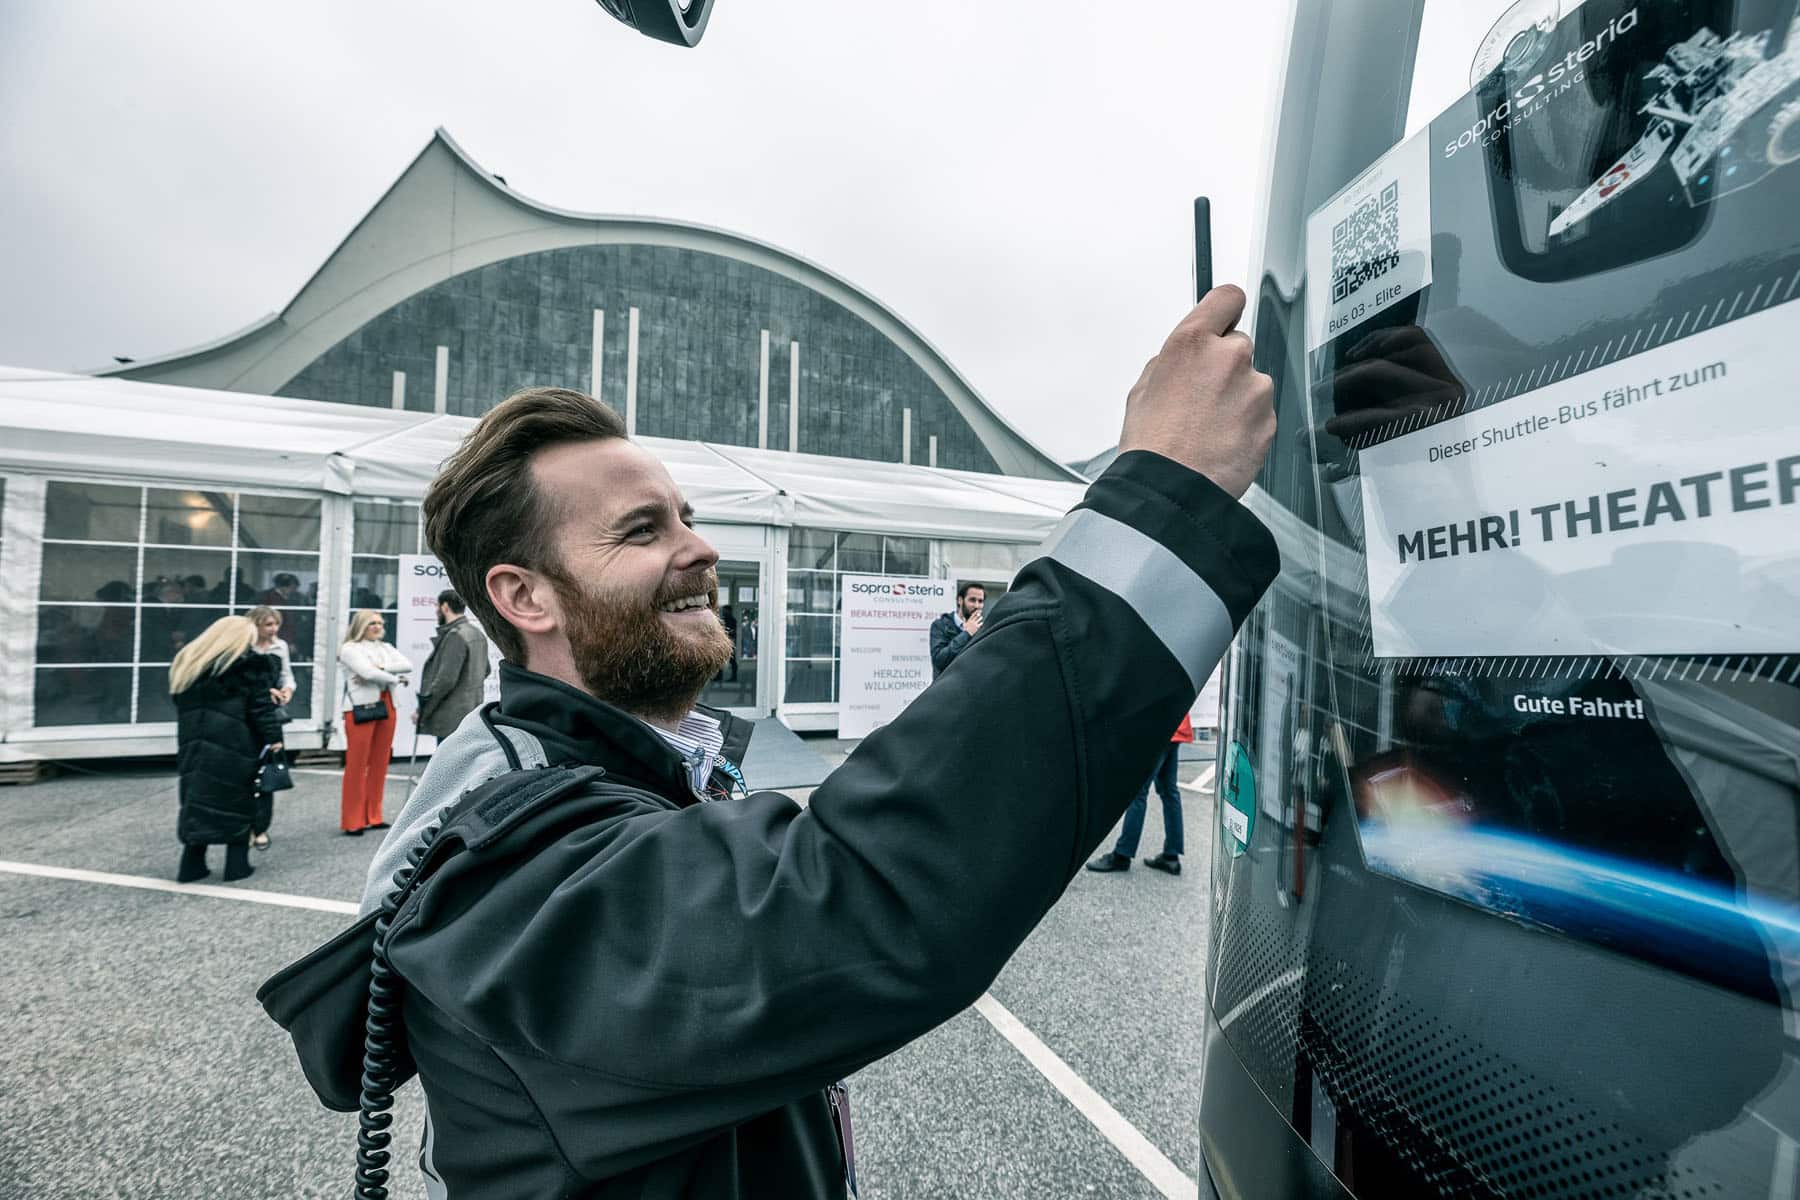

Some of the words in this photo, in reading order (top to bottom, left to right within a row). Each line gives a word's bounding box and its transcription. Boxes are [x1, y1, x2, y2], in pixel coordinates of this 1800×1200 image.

[1444, 99, 1511, 159] sopra
[1547, 7, 1638, 84] steria
[1481, 71, 1585, 148] CONSULTING
[1329, 314, 1349, 333] Bus
[1351, 303, 1365, 320] 03
[1376, 284, 1402, 306] Elite
[1428, 436, 1478, 463] Dieser
[1481, 399, 1598, 448] Shuttle-Bus
[1602, 377, 1662, 411] fährt
[1668, 361, 1727, 392] zum
[1398, 509, 1521, 564] MEHR!
[851, 583, 890, 596] sopra
[908, 584, 944, 597] steria
[850, 609, 922, 619] BERATERTREFFEN
[864, 681, 930, 691] WILLKOMMEN
[873, 669, 921, 678] HERZLICH
[1513, 694, 1565, 715] Gute
[1568, 697, 1645, 719] Fahrt!
